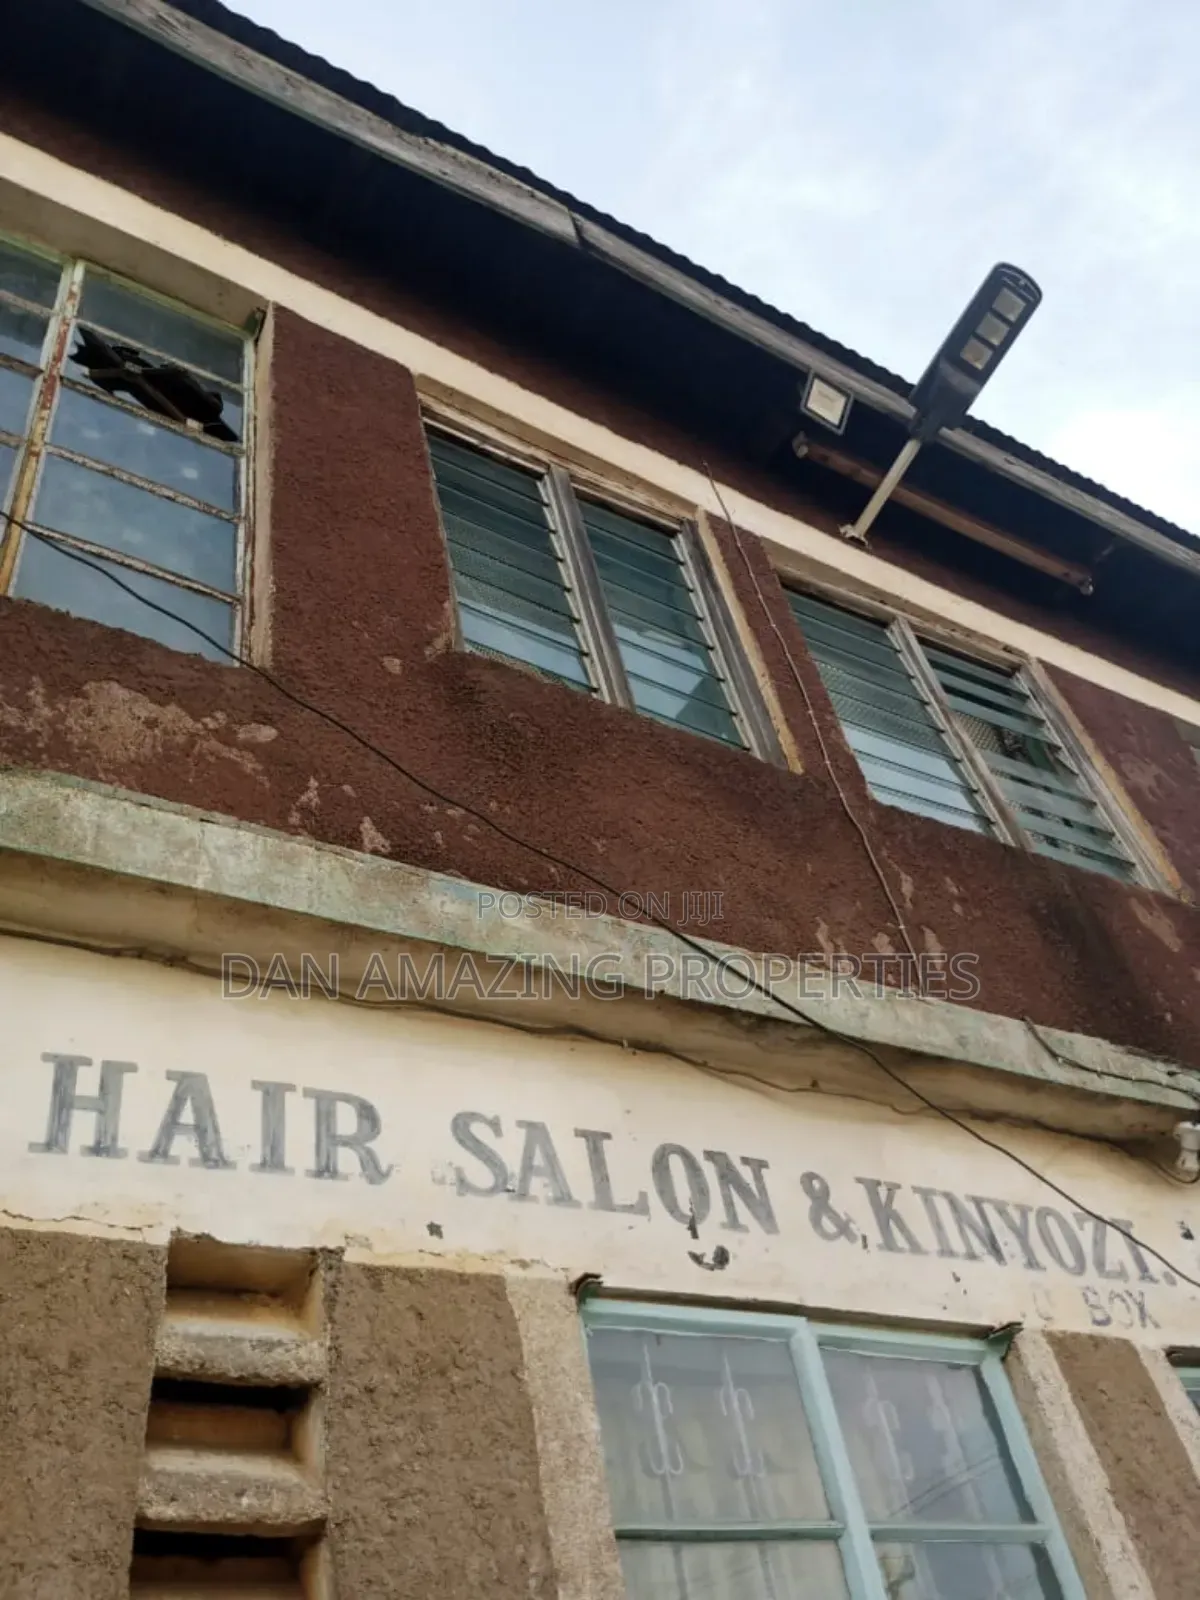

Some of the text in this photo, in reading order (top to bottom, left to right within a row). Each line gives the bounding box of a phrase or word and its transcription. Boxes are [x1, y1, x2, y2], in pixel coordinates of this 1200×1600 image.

[28, 1051, 393, 1185] HAIR
[449, 1111, 779, 1235] SALON
[800, 1171, 858, 1243] &
